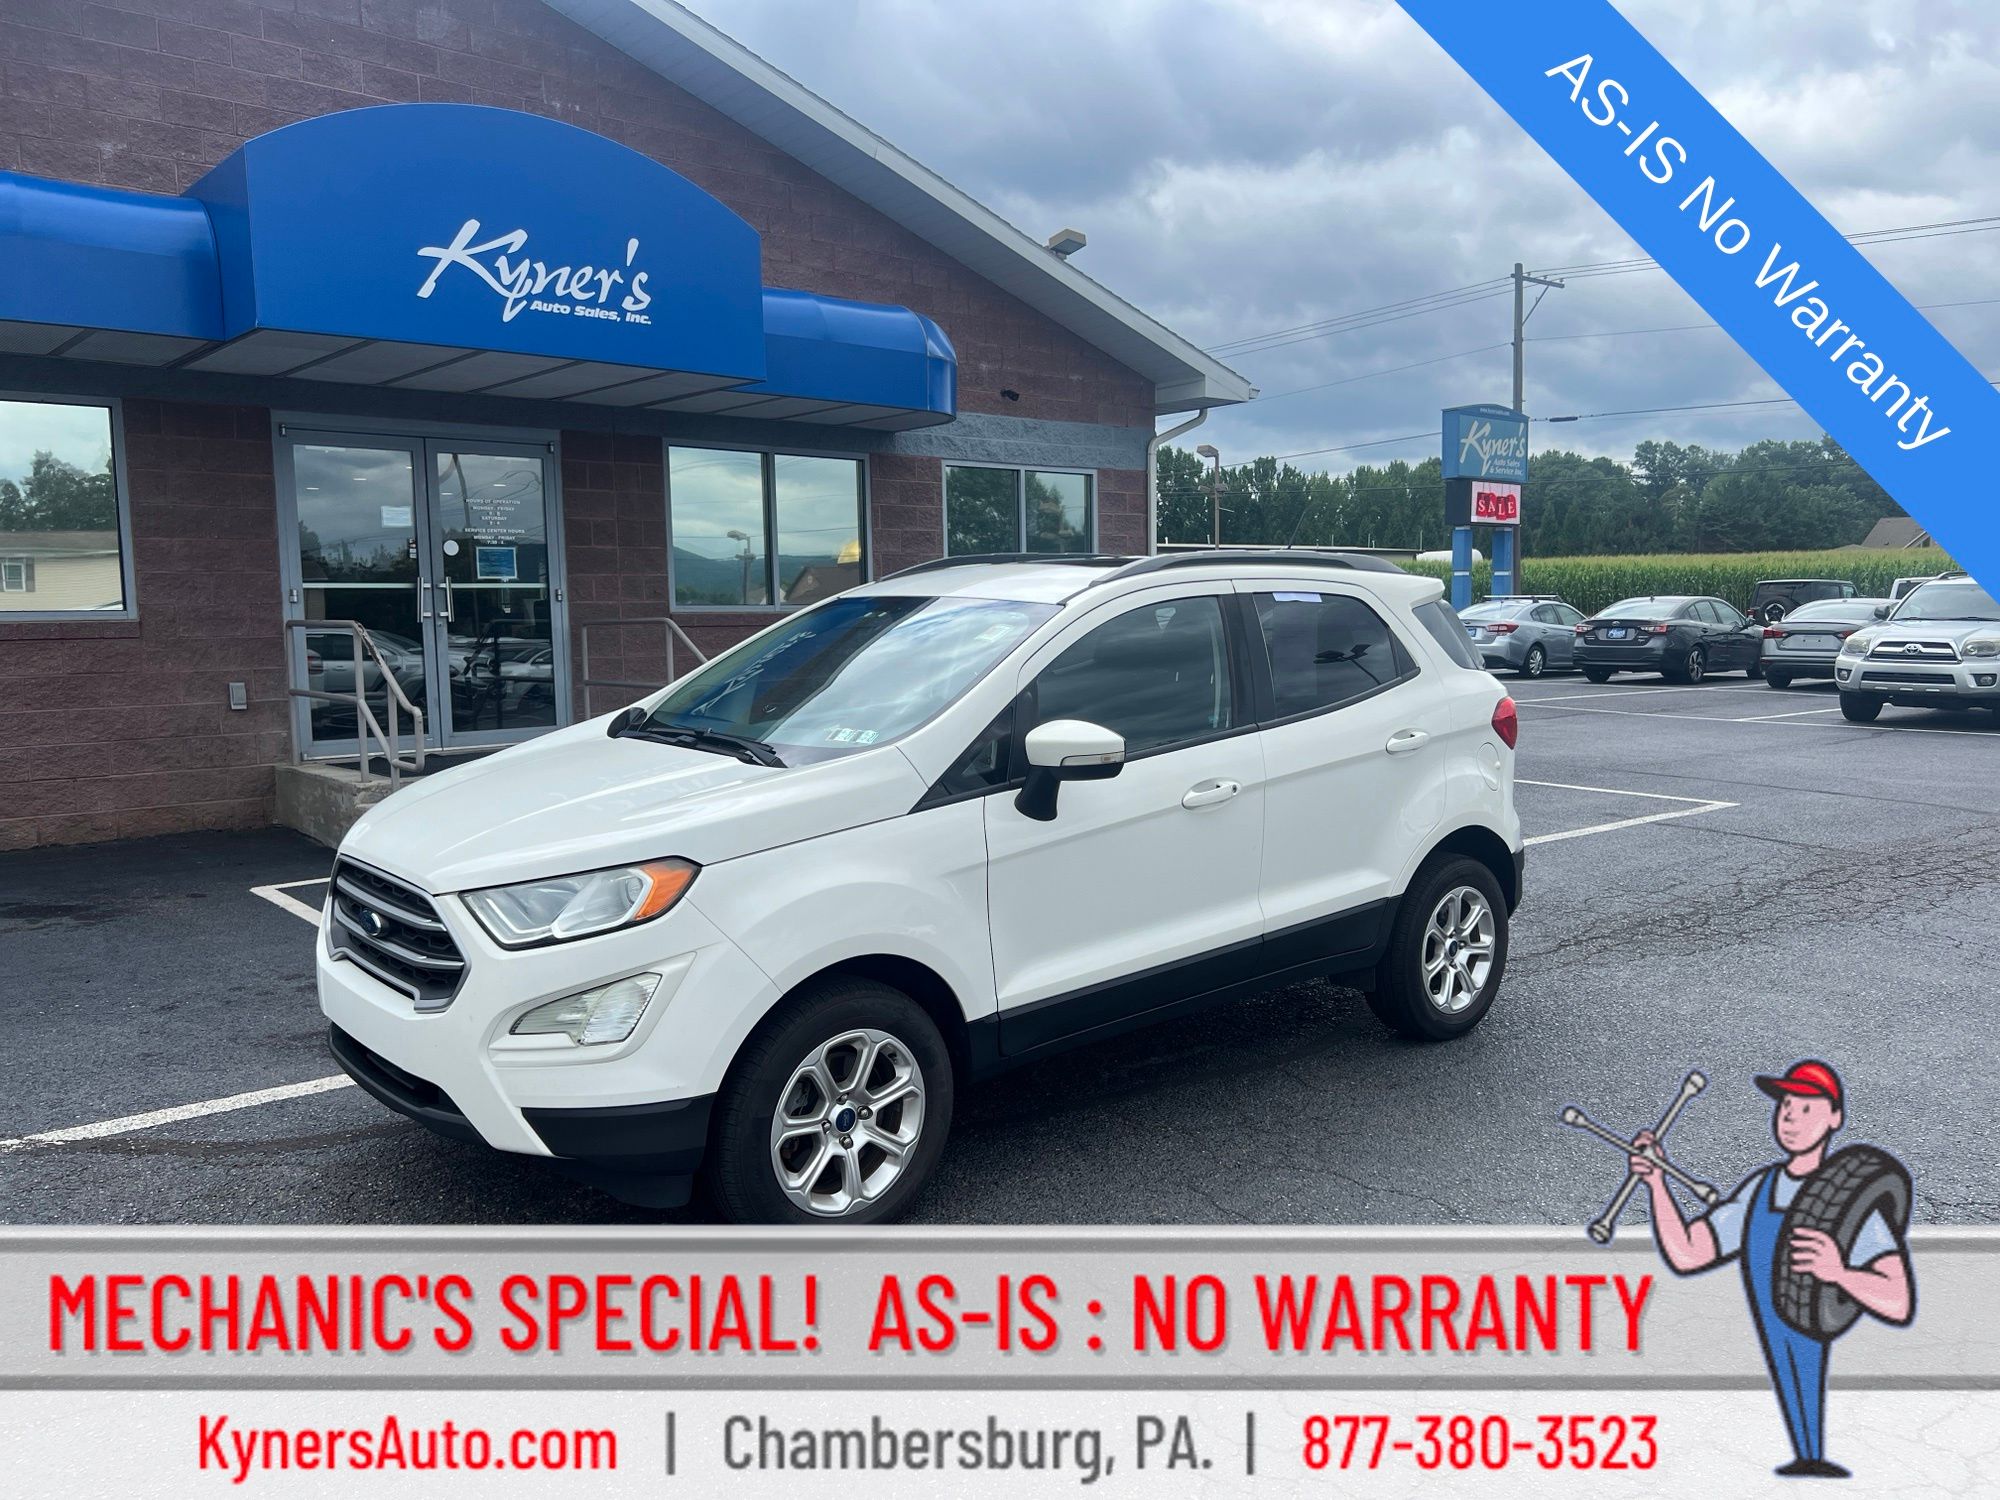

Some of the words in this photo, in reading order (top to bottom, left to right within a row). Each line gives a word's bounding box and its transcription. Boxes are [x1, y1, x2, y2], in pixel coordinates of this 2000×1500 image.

[416, 218, 652, 323] Kyner's
[530, 300, 571, 314] Auto
[574, 305, 620, 322] Sales,
[625, 312, 652, 325] Inc.
[1459, 419, 1525, 476] Kyner's
[1478, 500, 1515, 515] SALE
